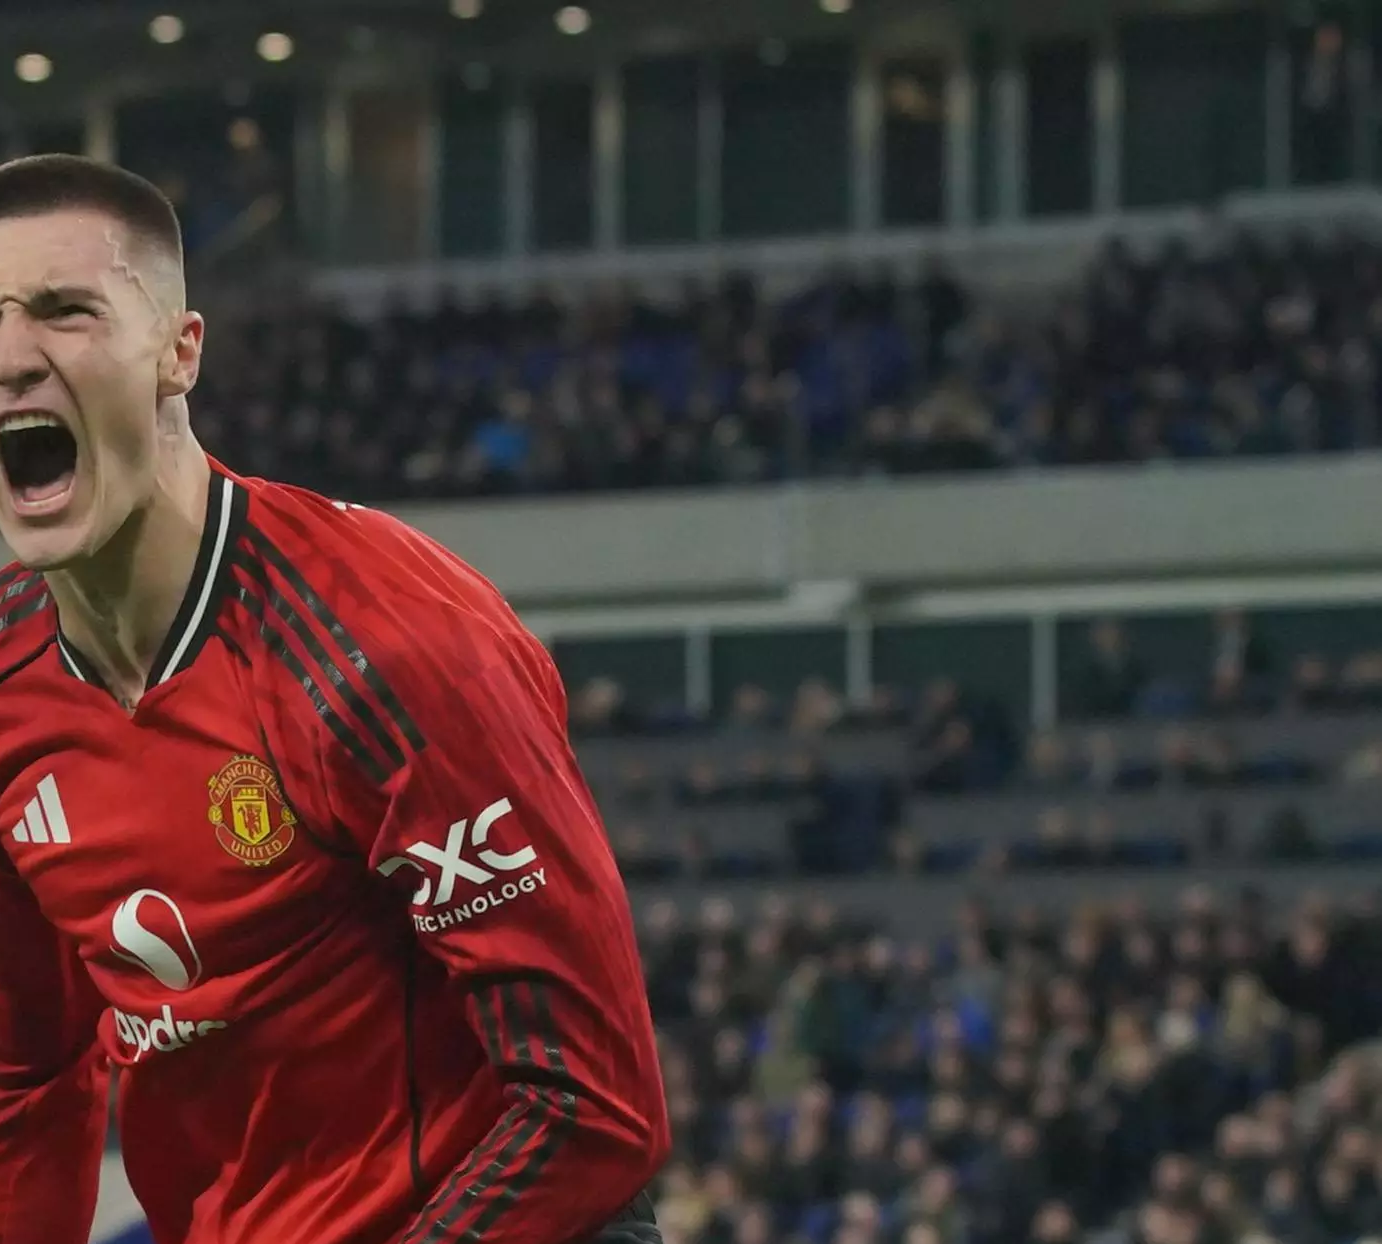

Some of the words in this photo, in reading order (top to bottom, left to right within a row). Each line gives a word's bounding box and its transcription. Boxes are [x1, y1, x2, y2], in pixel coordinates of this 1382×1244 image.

[214, 762, 282, 799] MANCHEST
[230, 839, 283, 858] UNITED
[413, 868, 547, 932] TECHNOLOGY
